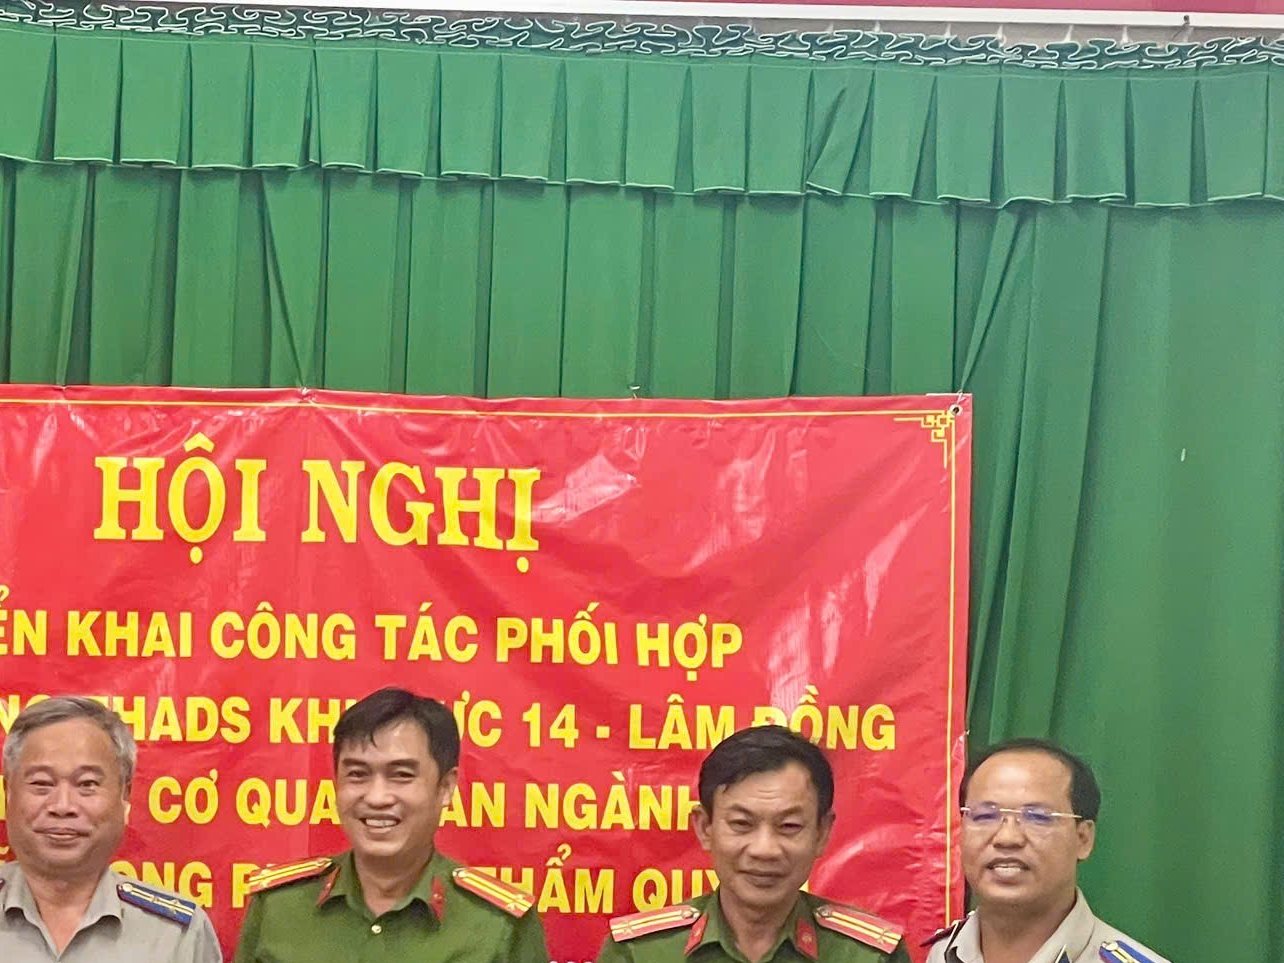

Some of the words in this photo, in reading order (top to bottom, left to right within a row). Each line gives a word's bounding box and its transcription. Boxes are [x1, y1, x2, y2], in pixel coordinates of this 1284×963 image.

[93, 432, 267, 564] HỘI
[301, 459, 542, 573] NGHỊ
[66, 610, 193, 658] KHAI
[210, 600, 356, 661] CÔNG
[375, 602, 479, 663] TÁC
[495, 602, 619, 666] PHỐI
[635, 613, 744, 682] HỢP
[522, 703, 579, 749] 14
[148, 769, 219, 825] CƠ
